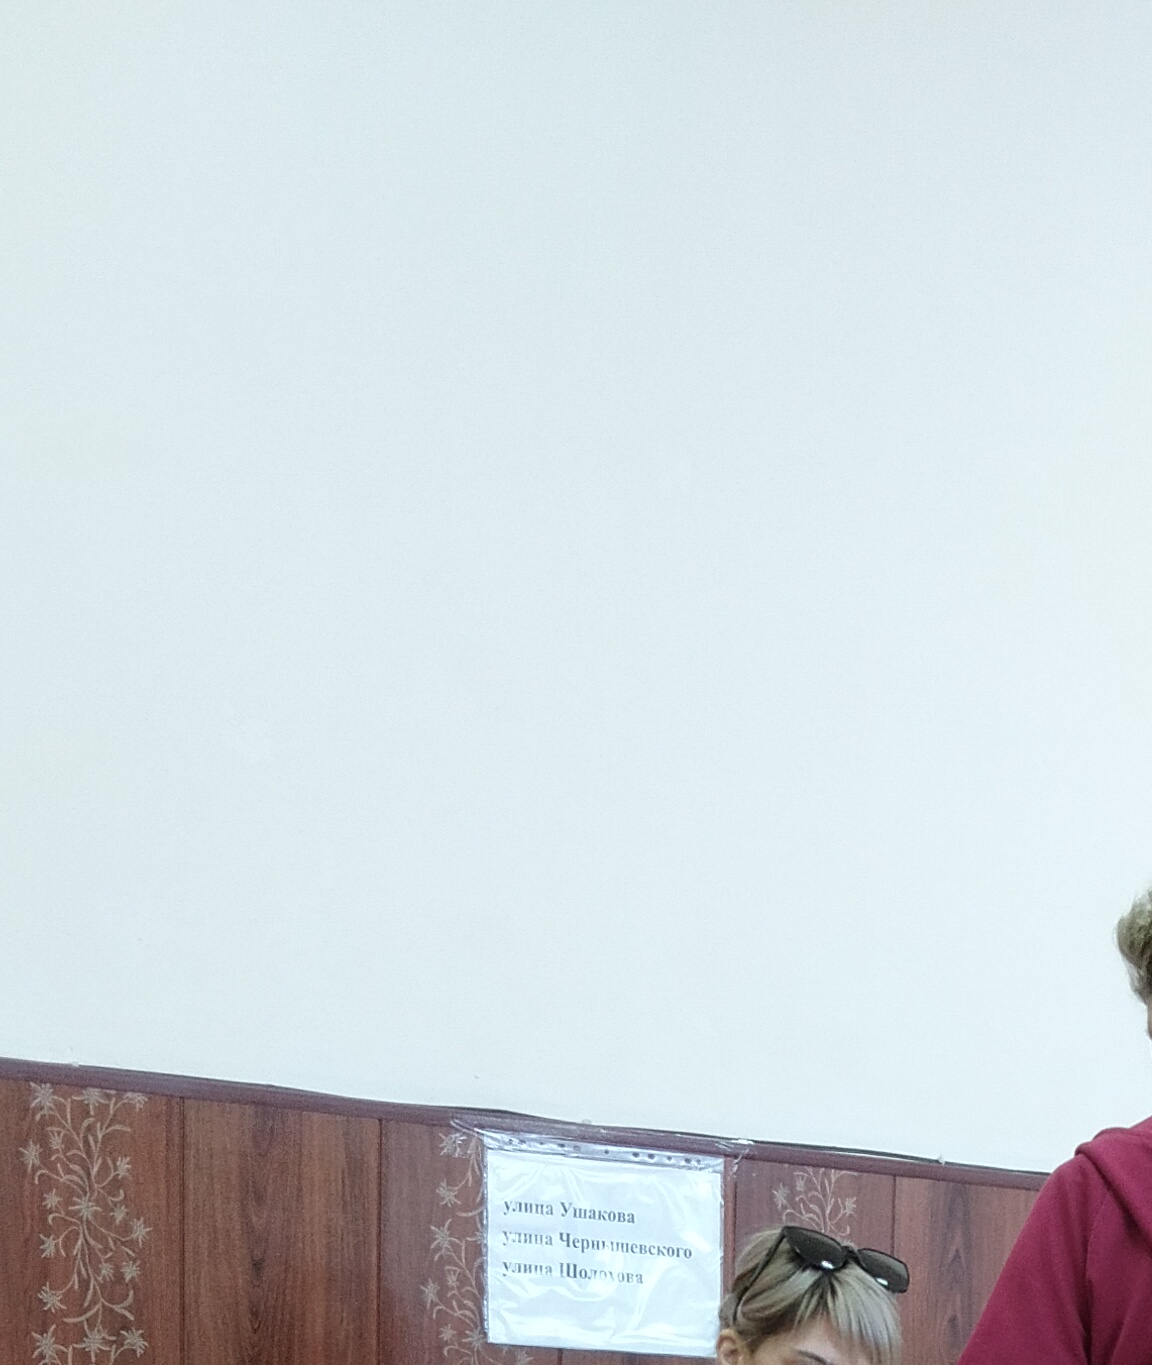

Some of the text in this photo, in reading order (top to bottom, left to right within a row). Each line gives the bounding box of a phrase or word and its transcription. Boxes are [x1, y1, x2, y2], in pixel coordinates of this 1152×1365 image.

[502, 1200, 636, 1225] улица Ушакова
[502, 1230, 553, 1247] улица
[502, 1260, 553, 1278] улица
